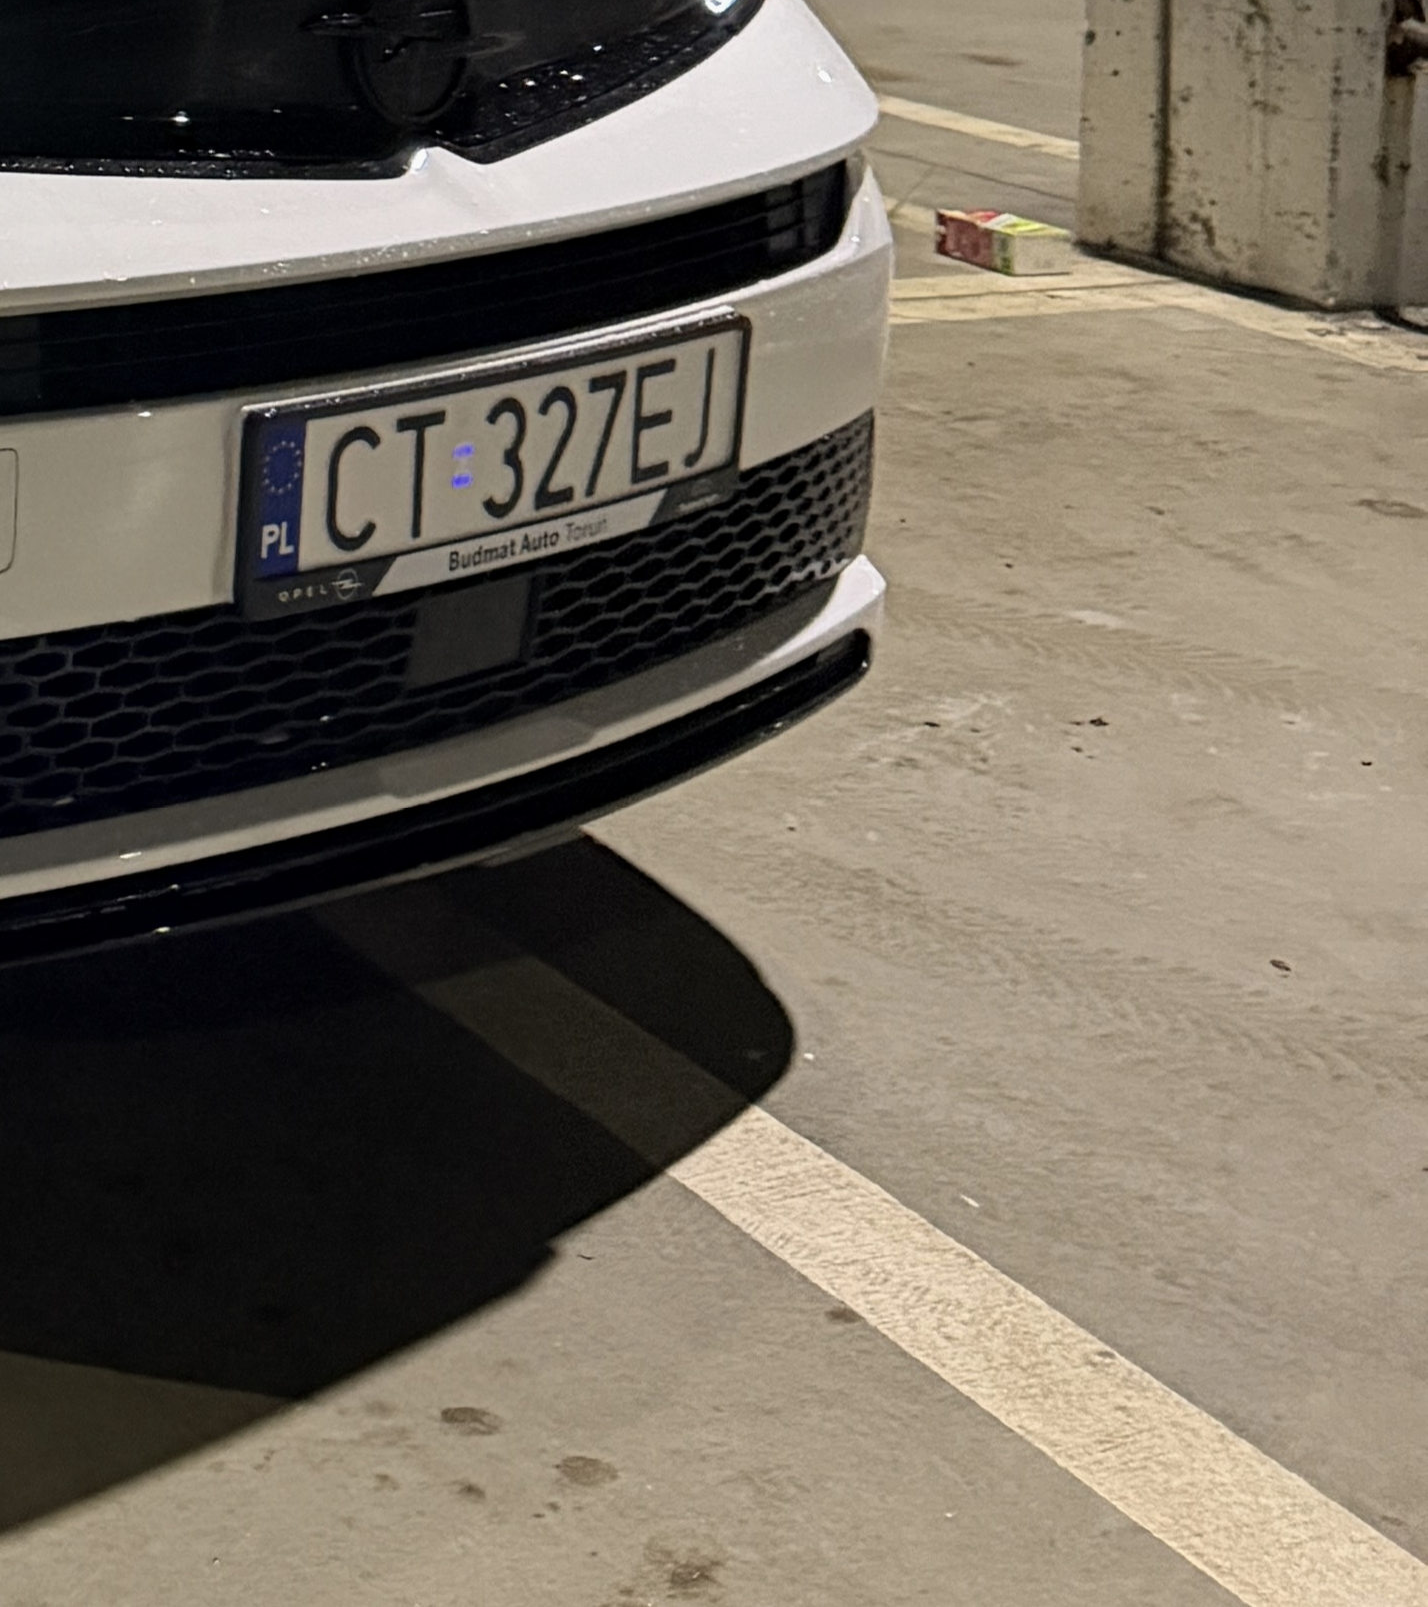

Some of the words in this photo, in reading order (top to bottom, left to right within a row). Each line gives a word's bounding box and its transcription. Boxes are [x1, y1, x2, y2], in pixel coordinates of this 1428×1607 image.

[326, 411, 446, 552] CT
[482, 348, 716, 519] 327EJ
[260, 523, 295, 559] PL
[448, 541, 517, 572] Budmat
[520, 530, 560, 554] Auto
